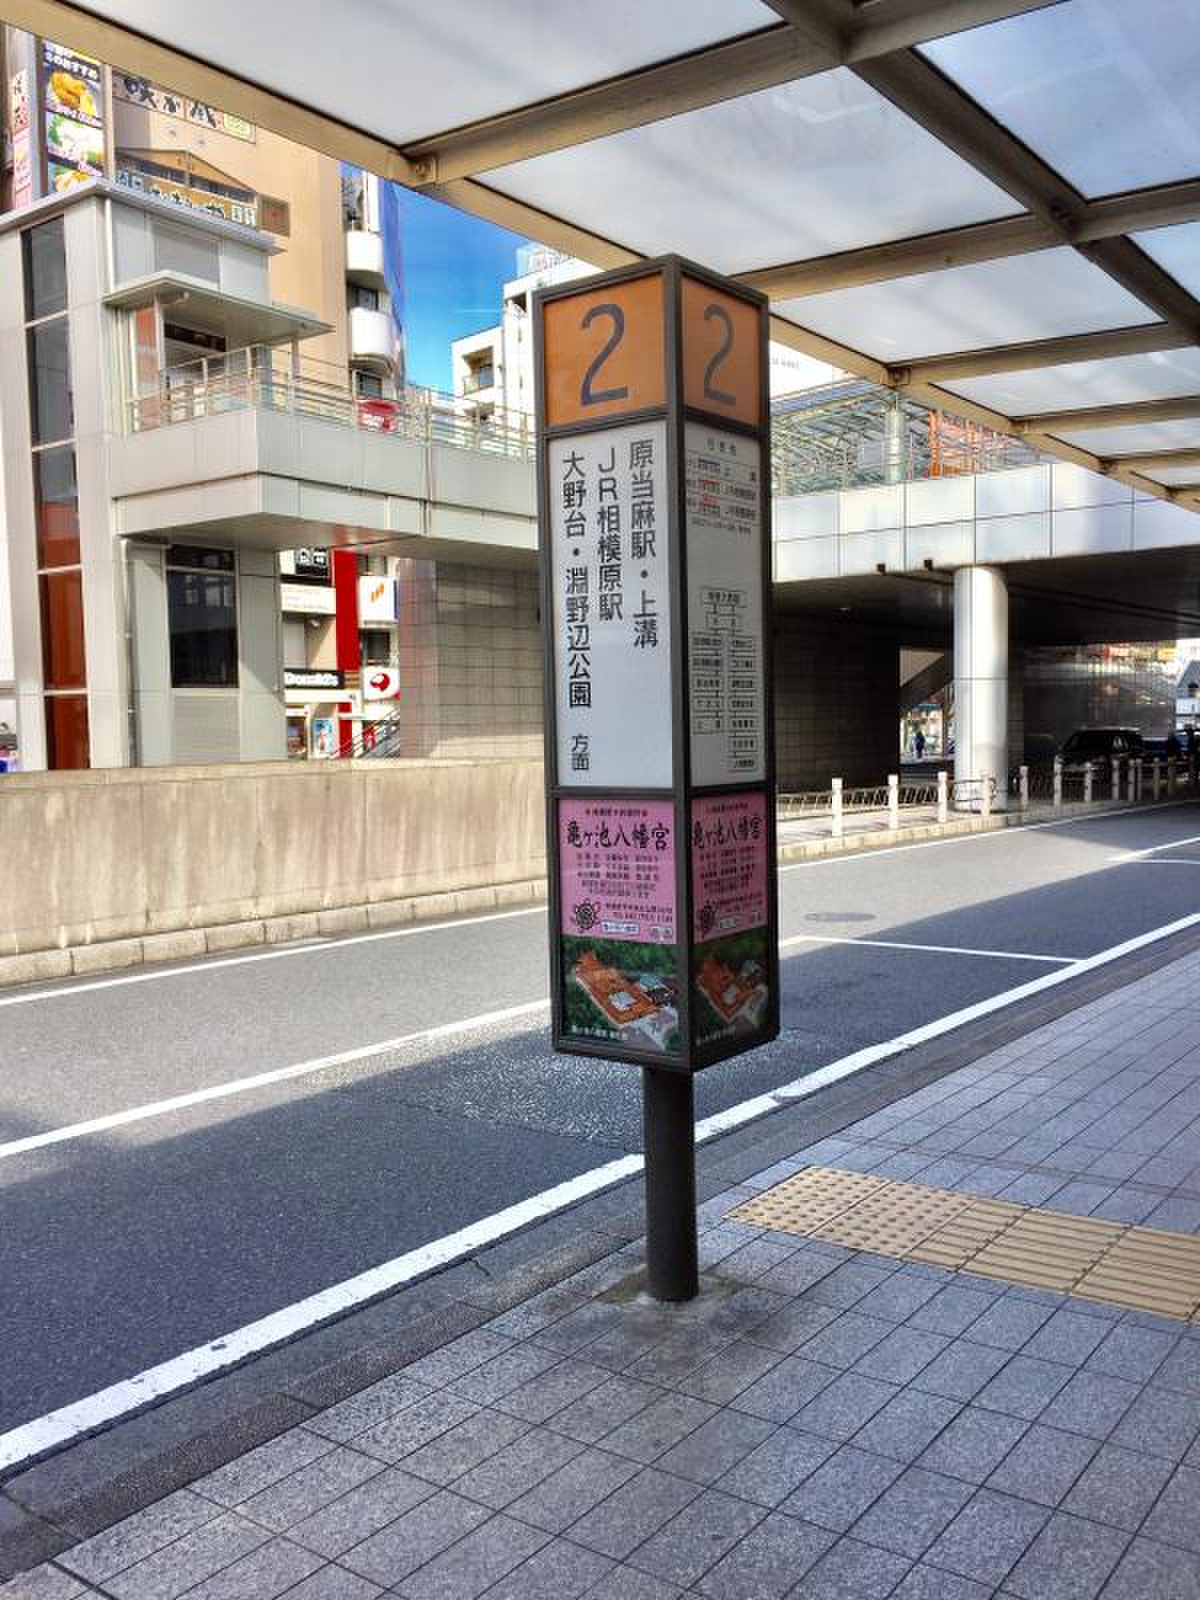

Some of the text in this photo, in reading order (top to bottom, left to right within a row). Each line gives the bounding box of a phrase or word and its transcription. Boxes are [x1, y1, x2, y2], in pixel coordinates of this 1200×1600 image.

[581, 303, 628, 407] 2
[703, 304, 737, 407] 2
[562, 450, 592, 772] 大野台・淵野辺公園 方面
[597, 447, 623, 621] JR相模原駅
[629, 439, 658, 649] 原当麻駅・上溝
